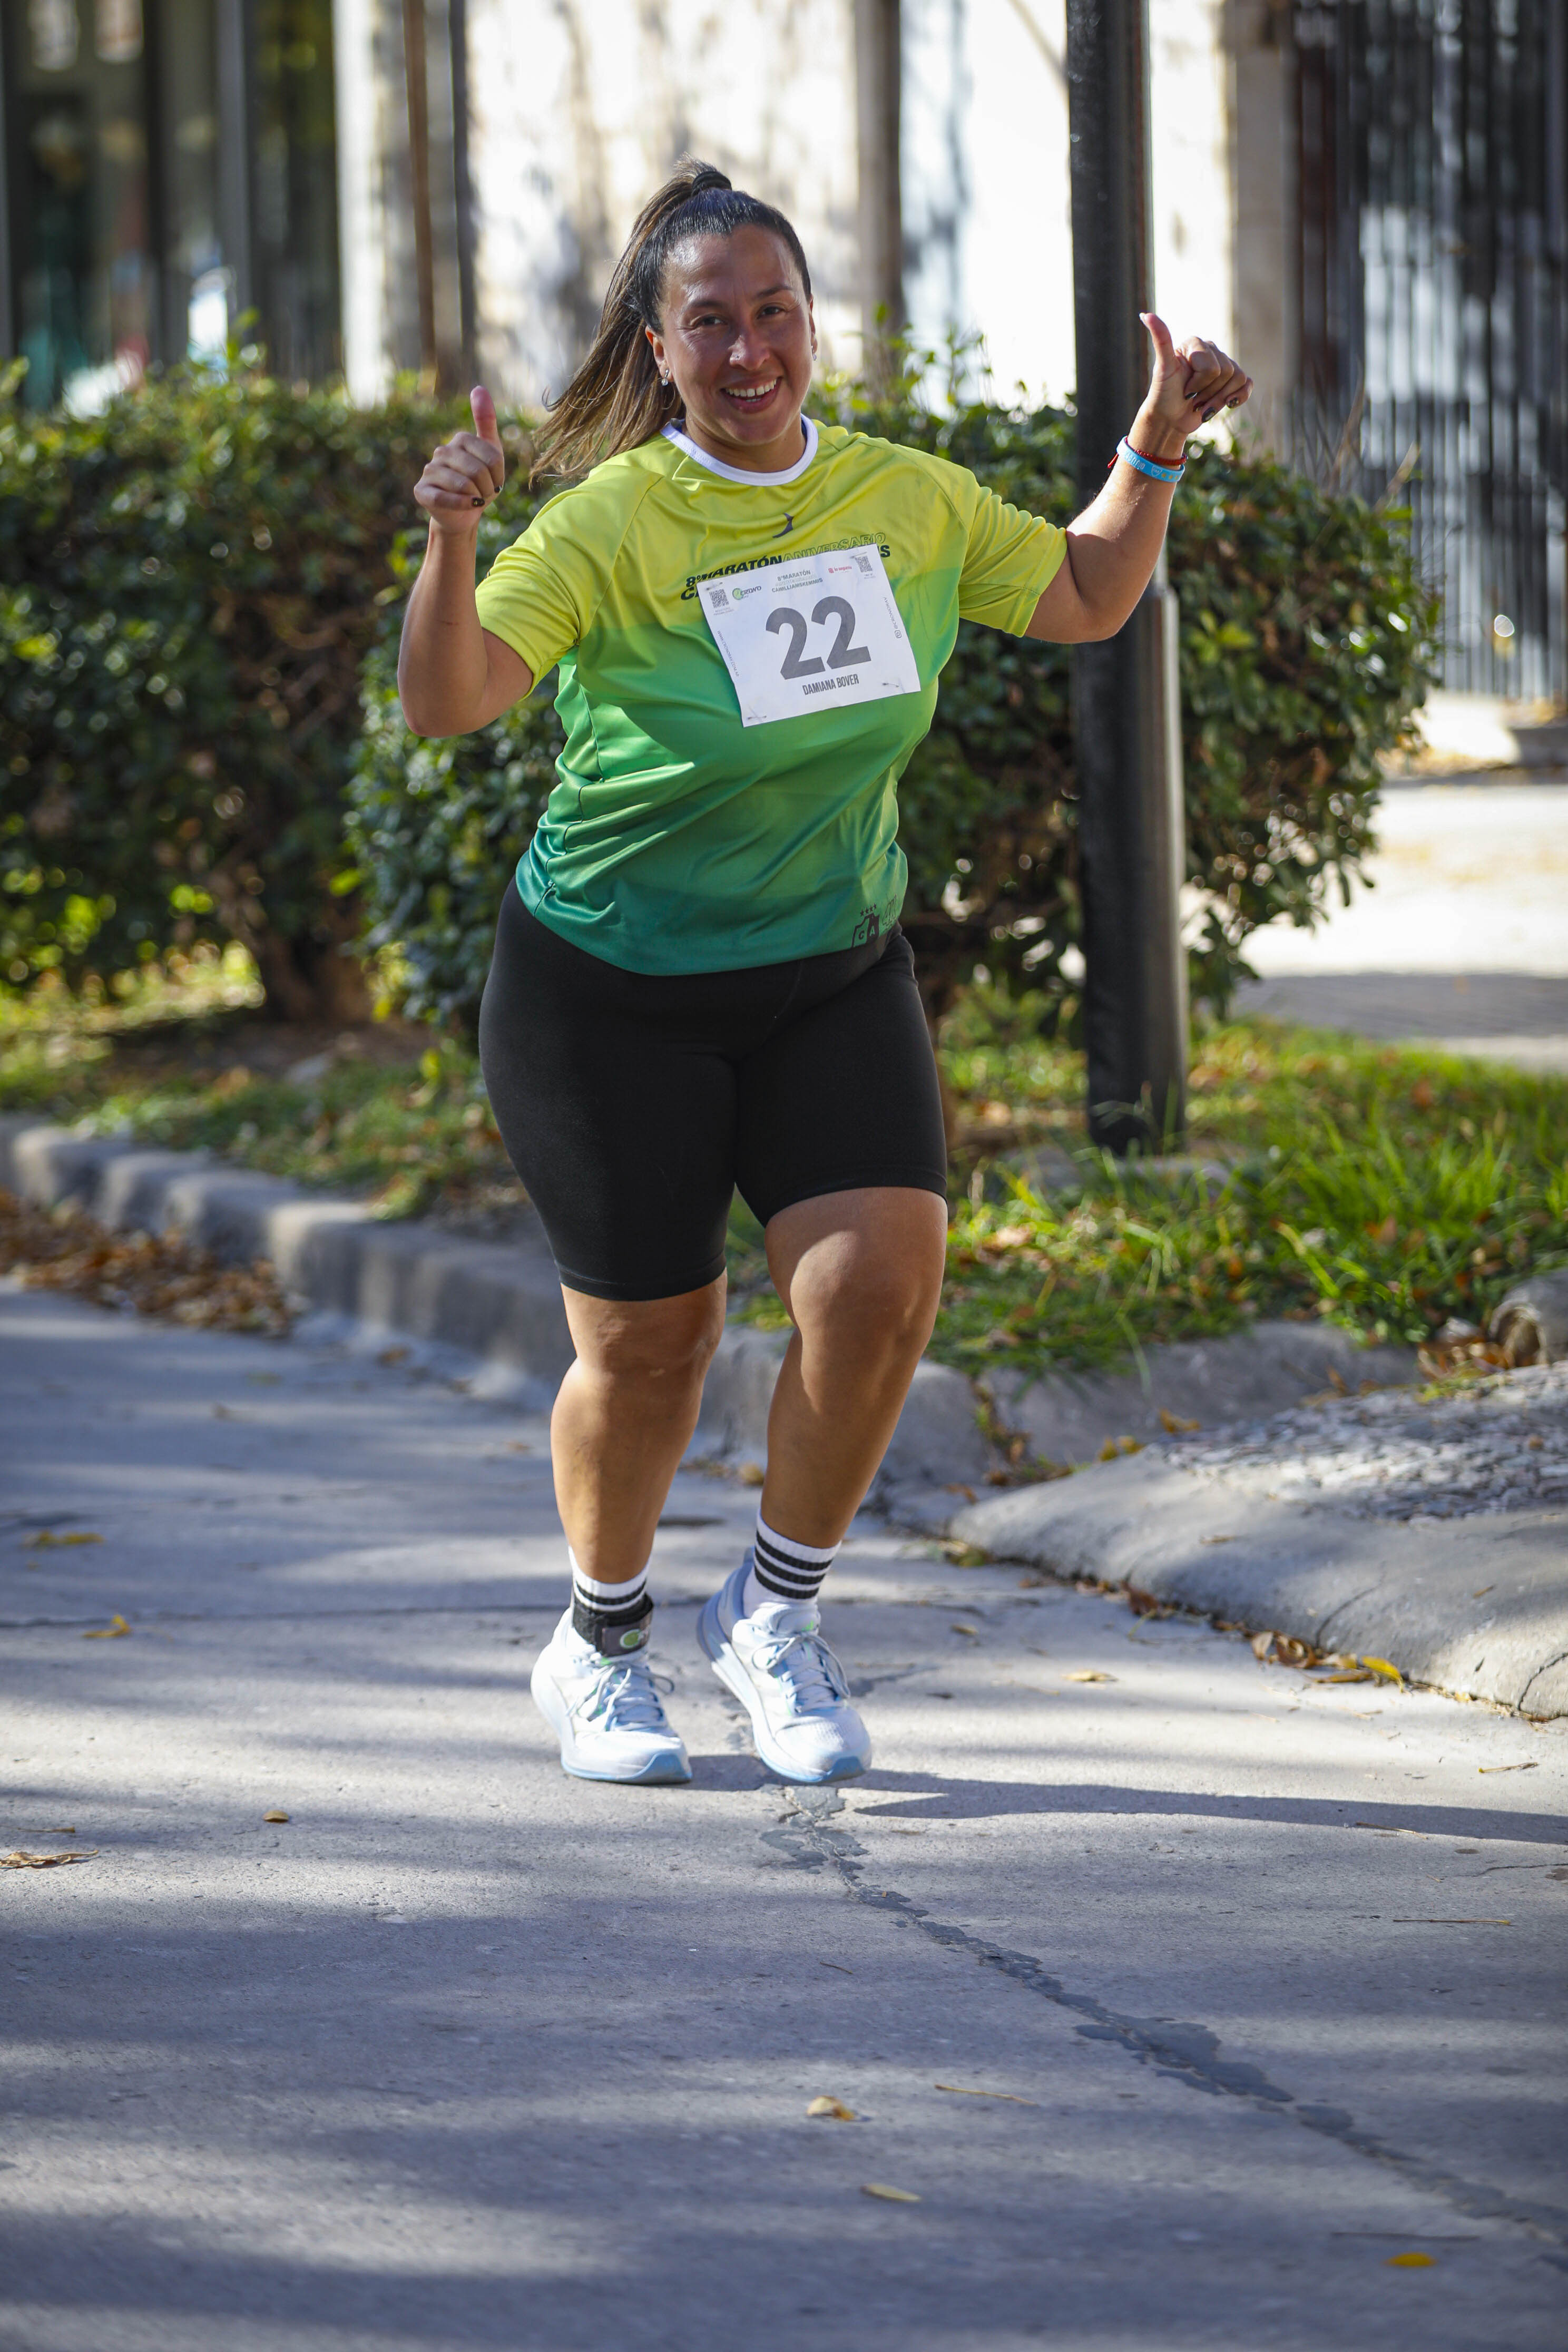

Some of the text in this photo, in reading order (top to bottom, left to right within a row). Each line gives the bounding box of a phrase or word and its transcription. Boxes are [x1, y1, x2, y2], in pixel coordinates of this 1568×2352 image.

[766, 595, 871, 680] 22
[802, 673, 859, 695] DAMIANA BOVER
